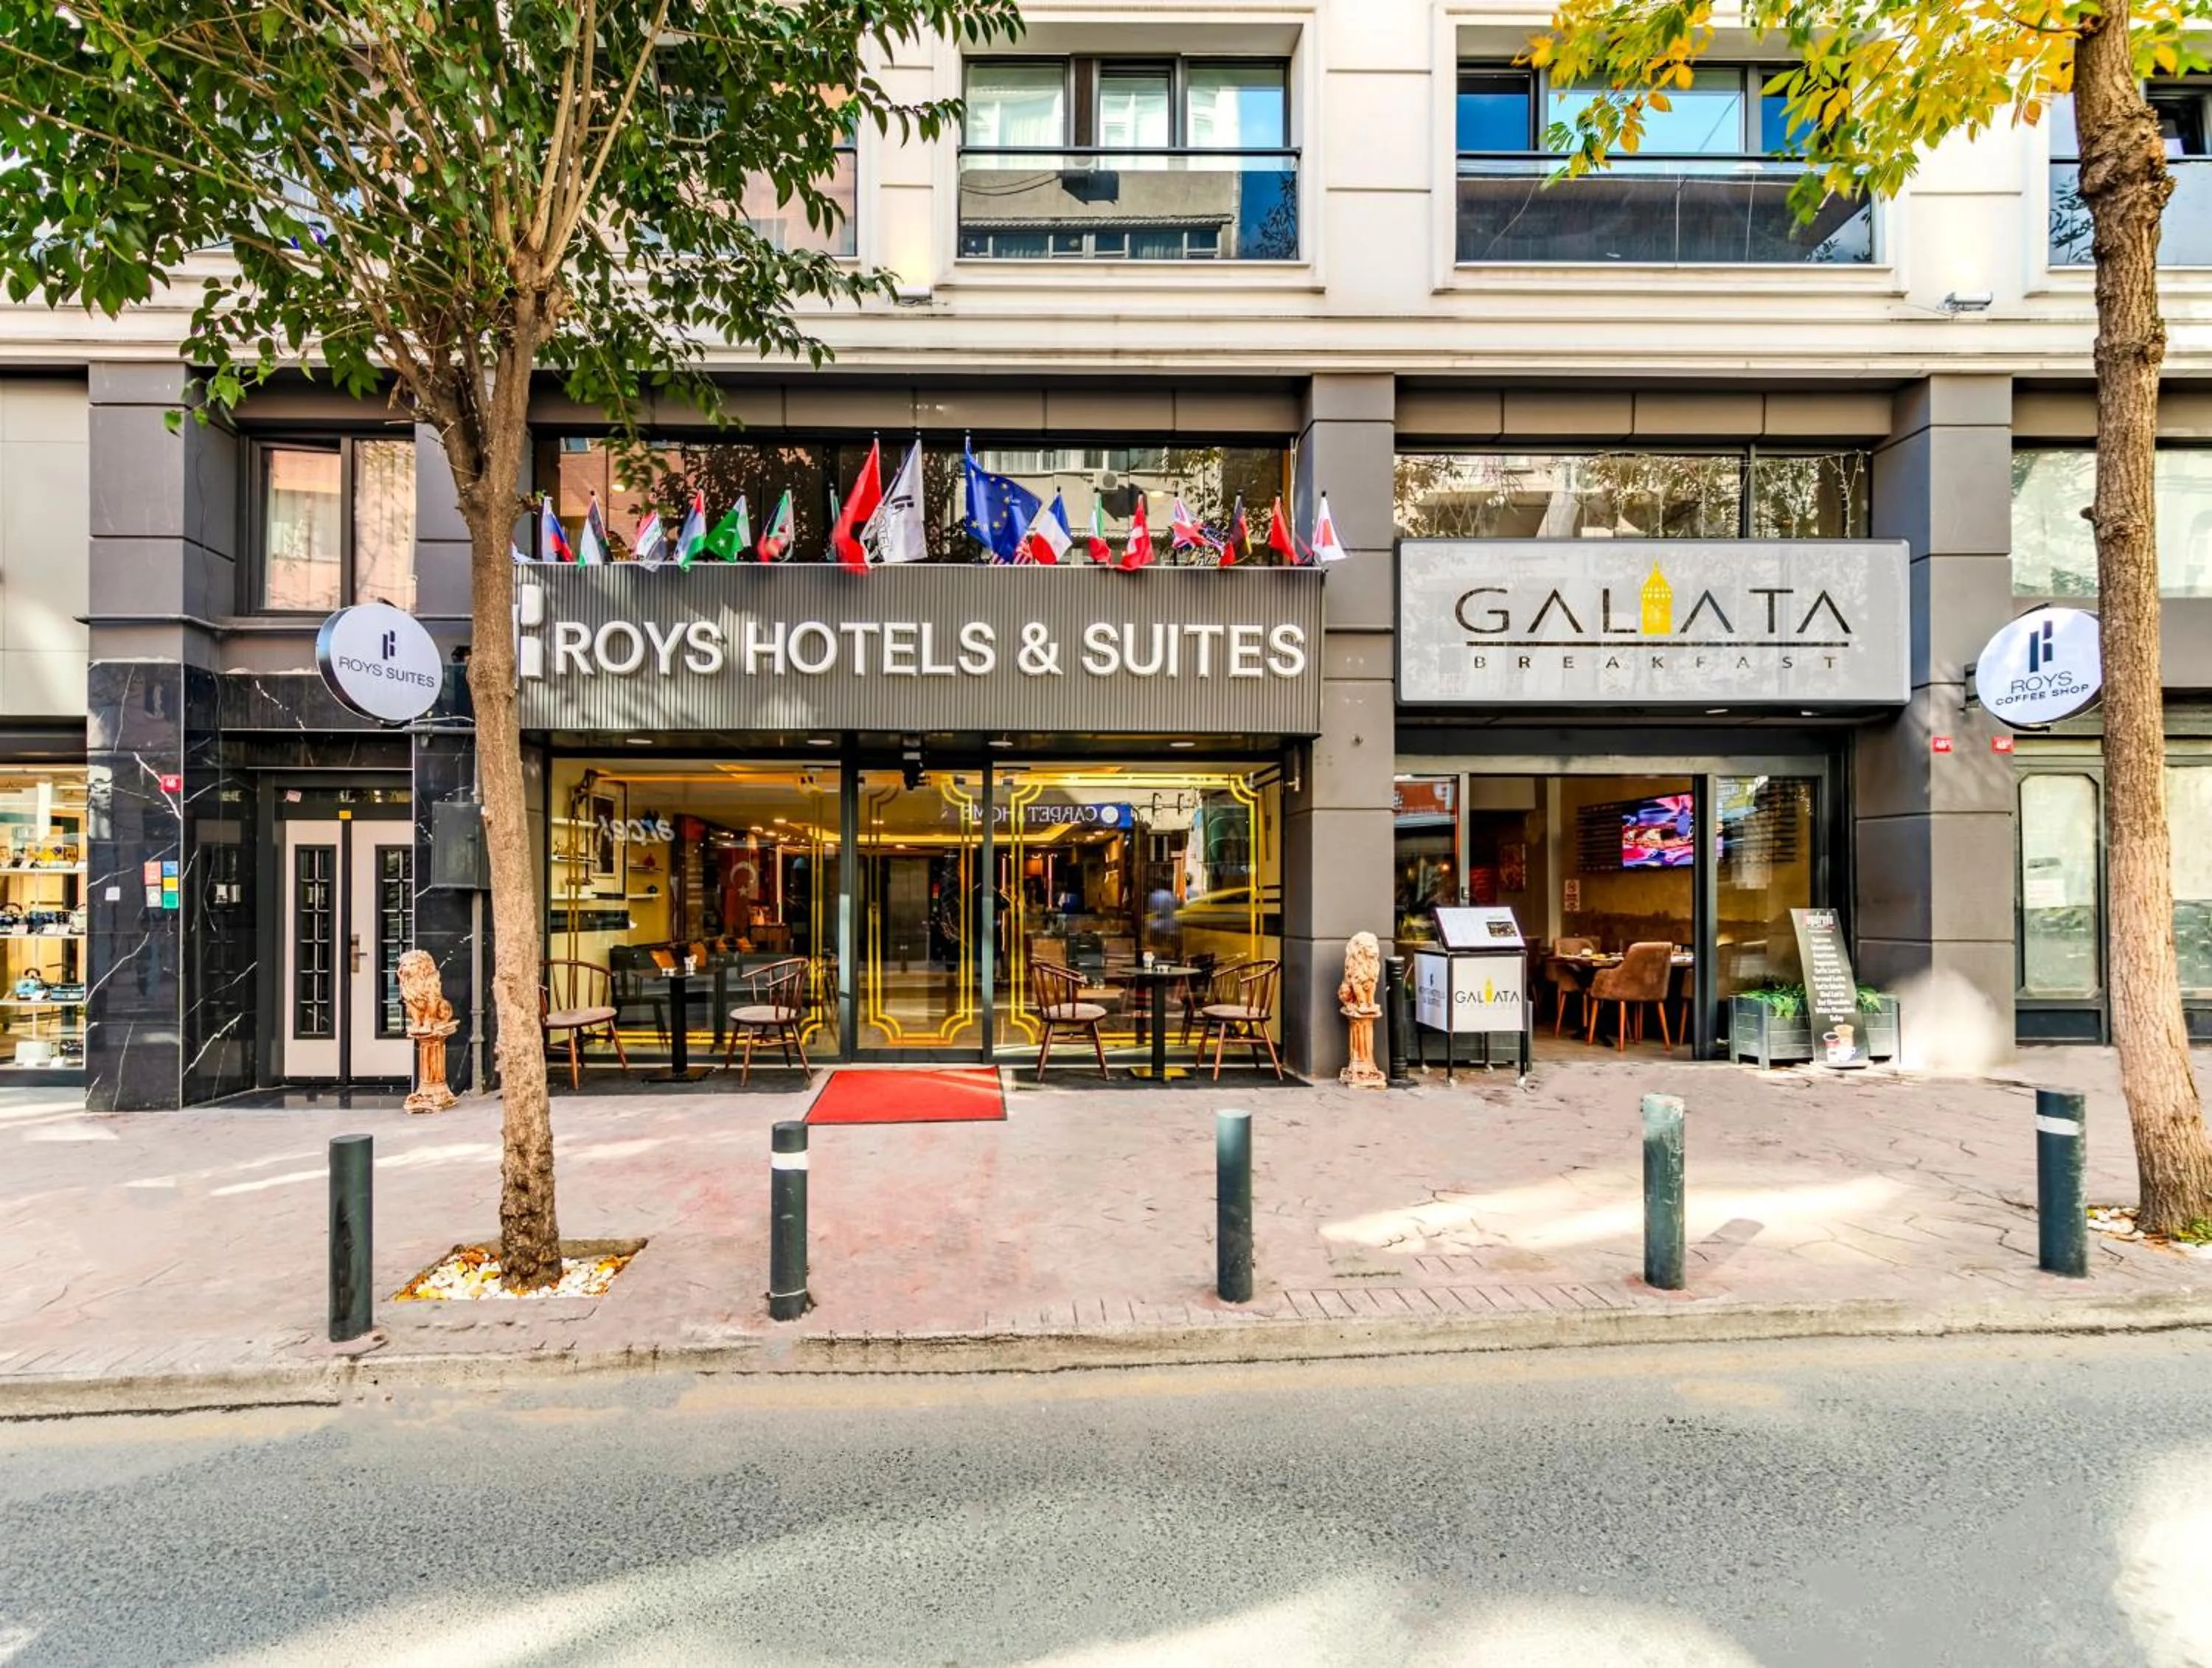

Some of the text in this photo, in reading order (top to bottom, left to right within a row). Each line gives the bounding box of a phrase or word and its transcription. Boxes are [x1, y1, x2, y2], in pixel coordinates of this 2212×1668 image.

[1455, 588, 1852, 634] GALATA
[555, 620, 1306, 678] ROYS HOTELS & SUITES
[338, 656, 435, 688] ROYS SUITES
[1474, 656, 1837, 670] BREAKFAST
[2010, 670, 2073, 694] ROYS
[1995, 684, 2090, 706] COFFEE SHOP
[1454, 990, 1520, 1004] GALATA
